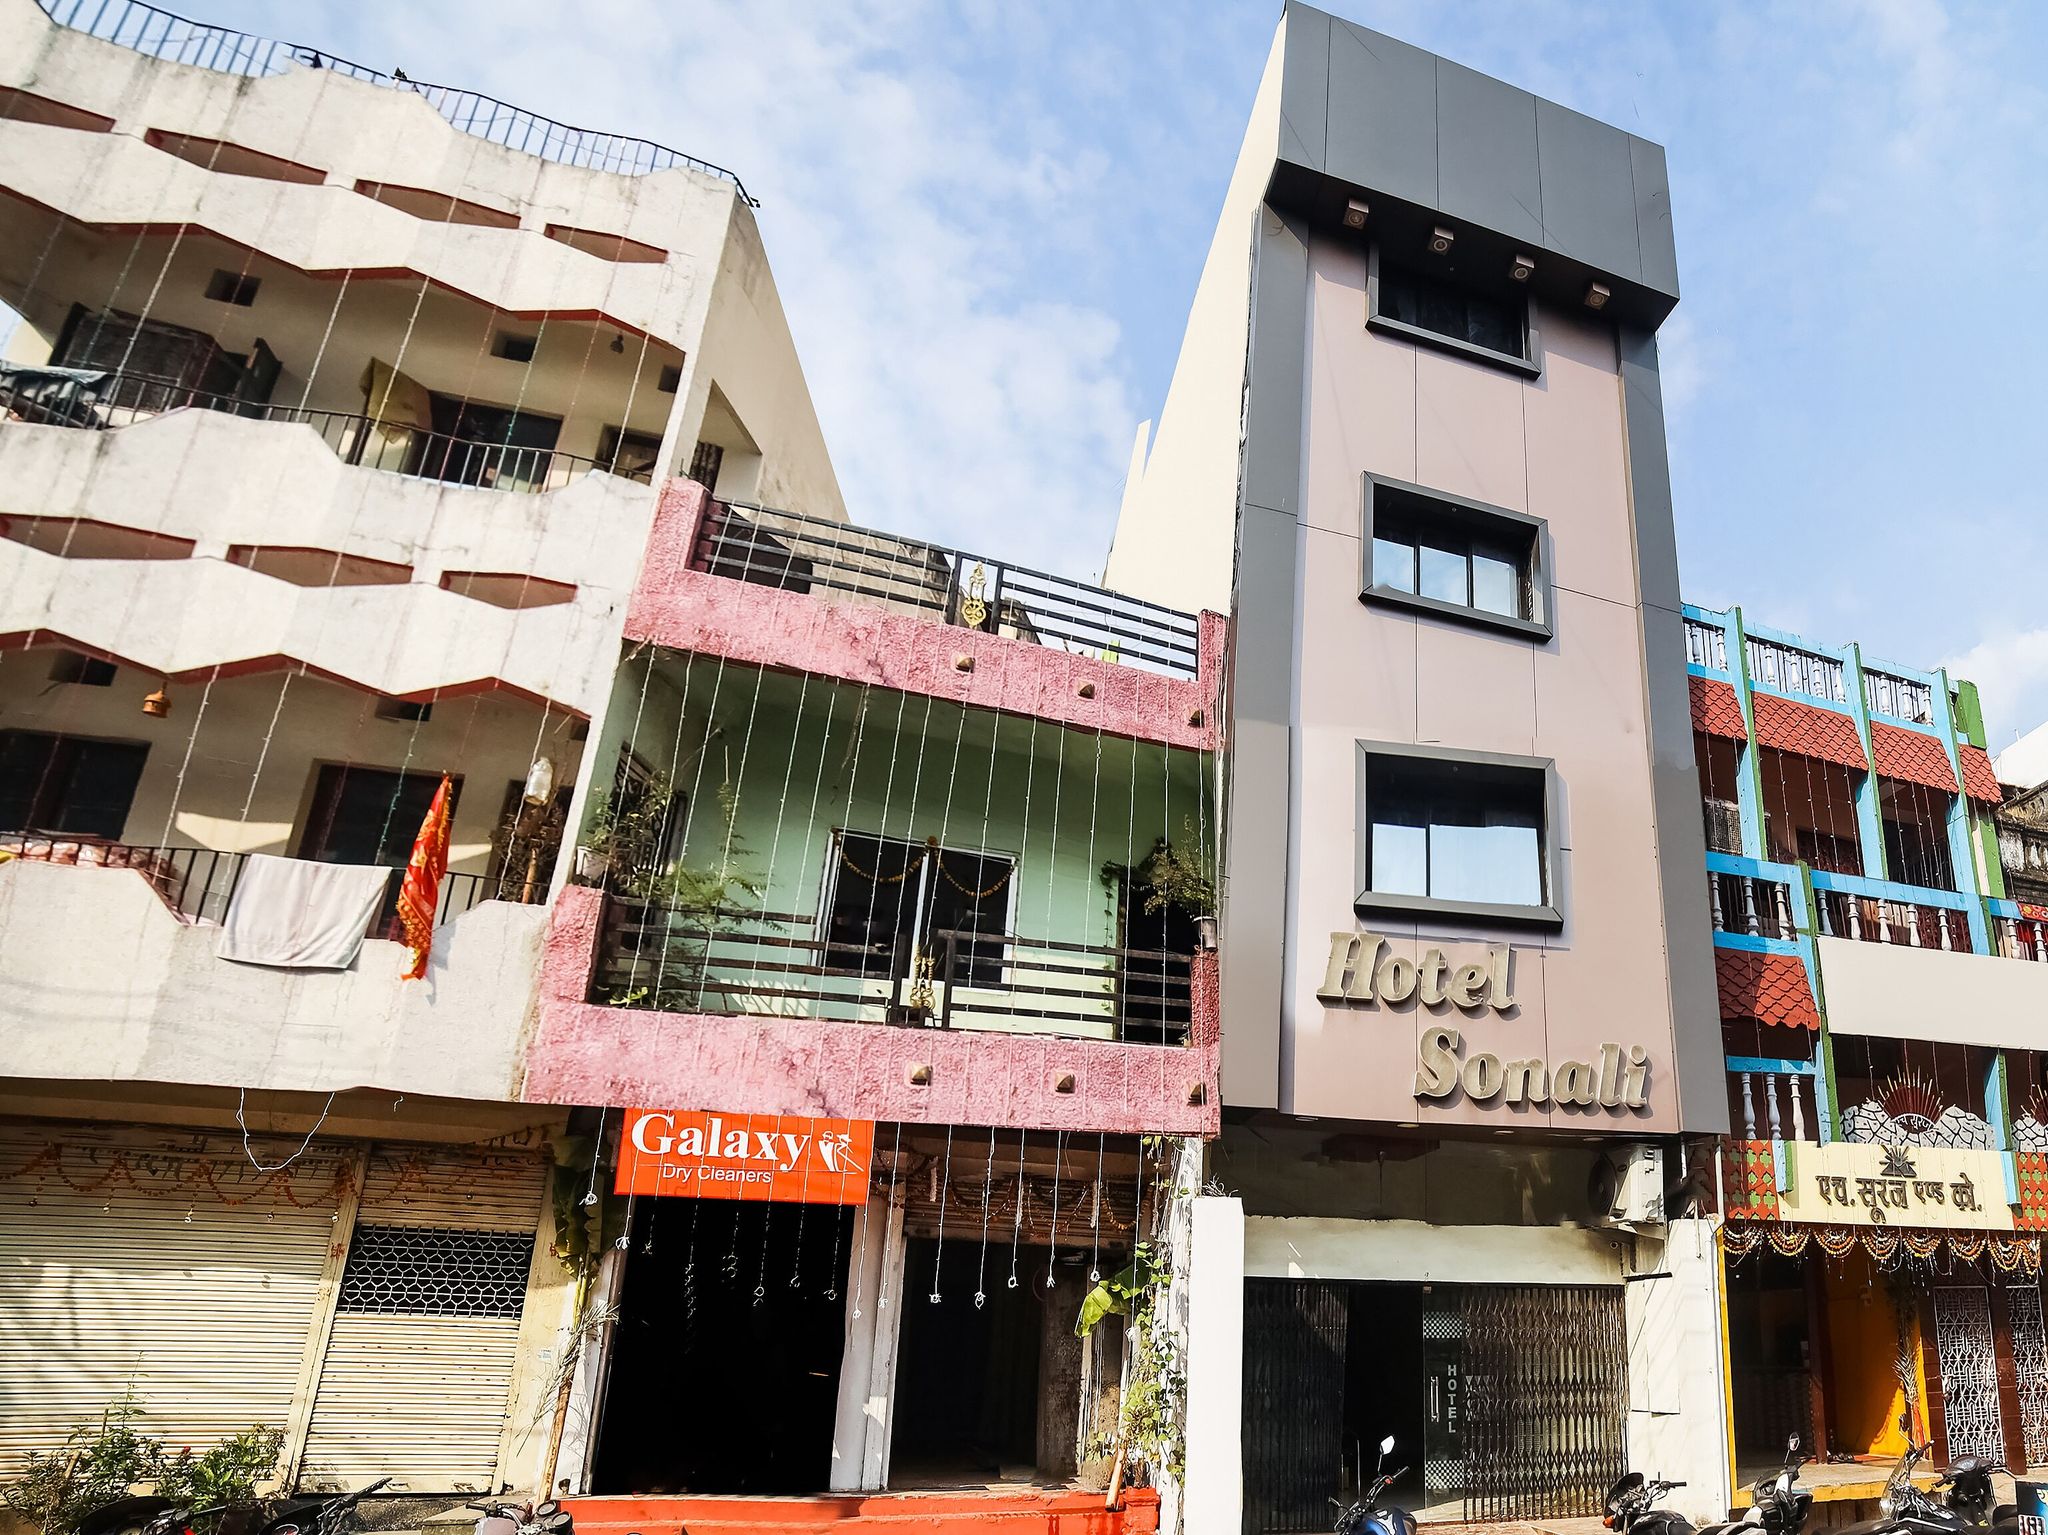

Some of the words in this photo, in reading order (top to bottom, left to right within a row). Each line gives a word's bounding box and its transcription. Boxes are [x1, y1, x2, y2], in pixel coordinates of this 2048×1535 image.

[1316, 931, 1516, 1010] Hotel
[1413, 1026, 1648, 1109] Sonali
[631, 1113, 811, 1173] Galaxy
[662, 1162, 694, 1183] Dry
[698, 1165, 772, 1184] Cleaners
[1912, 1180, 1946, 1205] एण्ड
[1447, 1364, 1457, 1433] HOTEL
